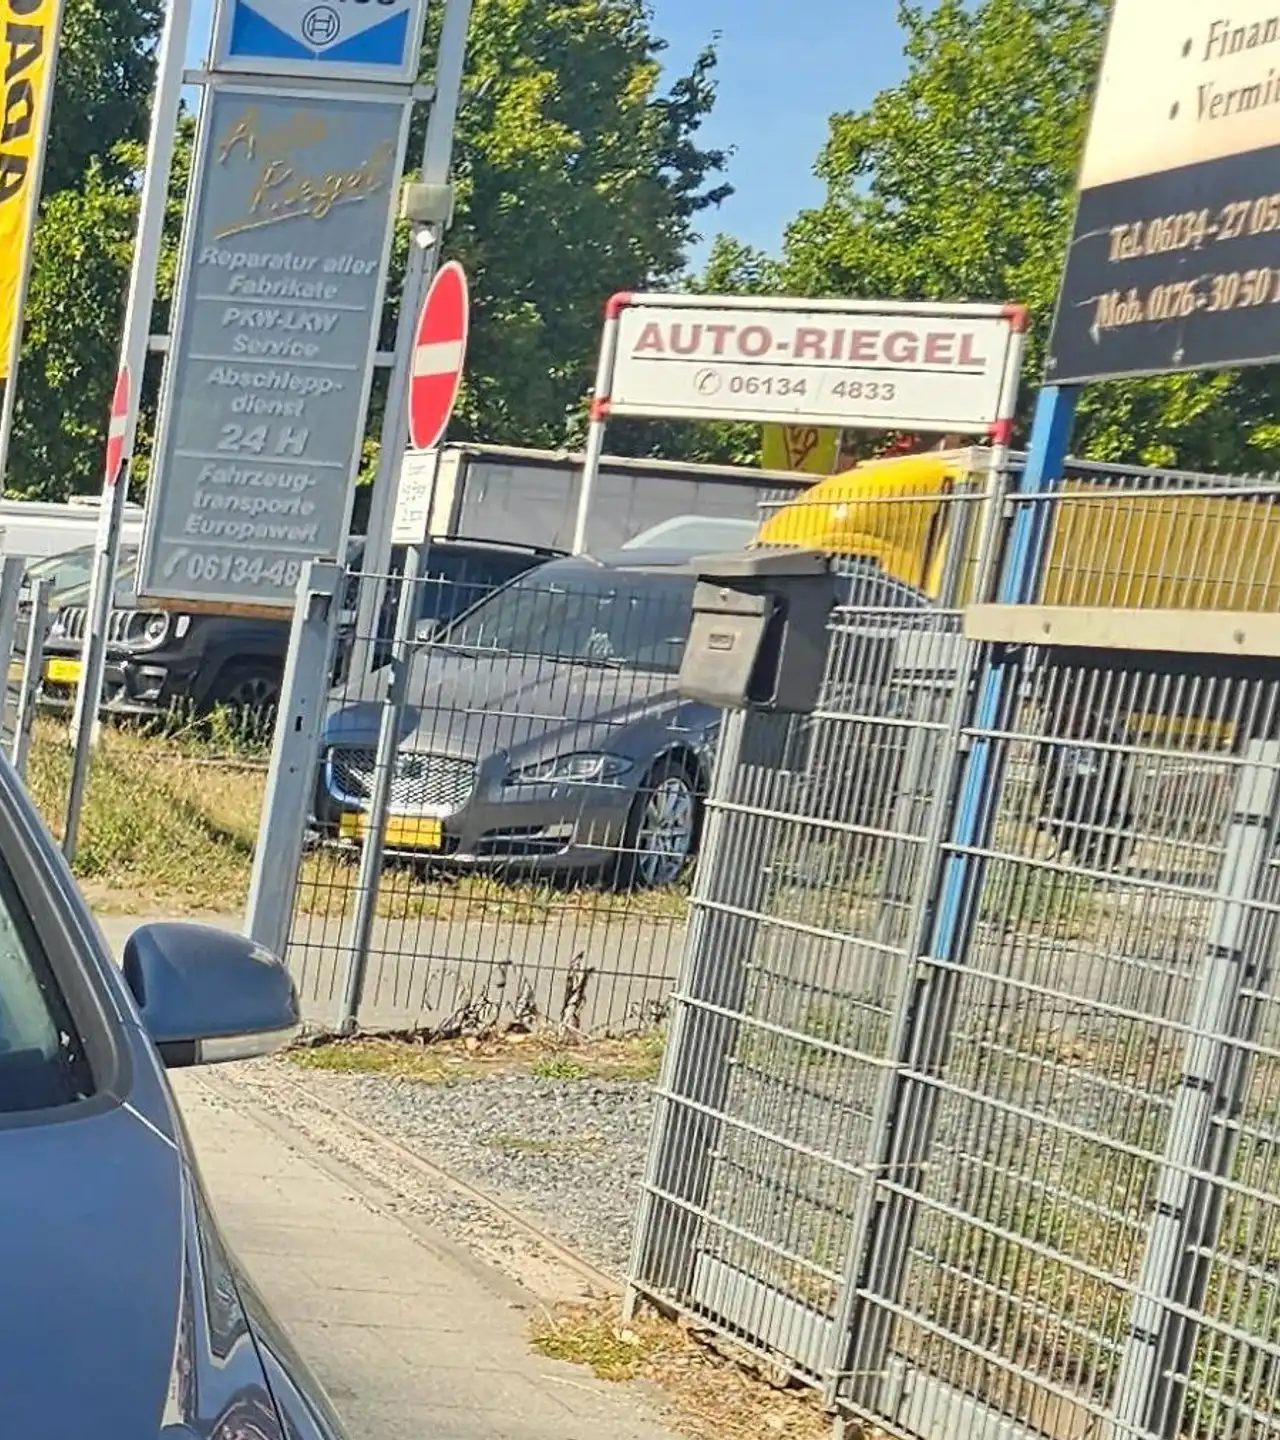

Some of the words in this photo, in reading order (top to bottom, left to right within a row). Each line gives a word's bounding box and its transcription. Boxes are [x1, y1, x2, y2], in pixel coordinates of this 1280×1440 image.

[1202, 16, 1280, 61] Finan
[199, 247, 320, 271] Reparatur
[323, 252, 377, 275] aller
[228, 274, 338, 298] Fabrikate
[222, 307, 339, 332] PKW-LKW
[233, 333, 320, 357] Service
[634, 322, 986, 367] AUTO-RIEGEL
[207, 366, 346, 396] Abschlepp-
[729, 376, 807, 397] 06134
[831, 380, 896, 401] 4833
[231, 393, 305, 417] dienst
[216, 423, 269, 453] 24
[274, 427, 310, 456] H
[197, 463, 317, 493] Fahrzeug-
[192, 490, 316, 516] transporte
[184, 513, 318, 543] Europaweit
[186, 553, 300, 587] 06134-48
